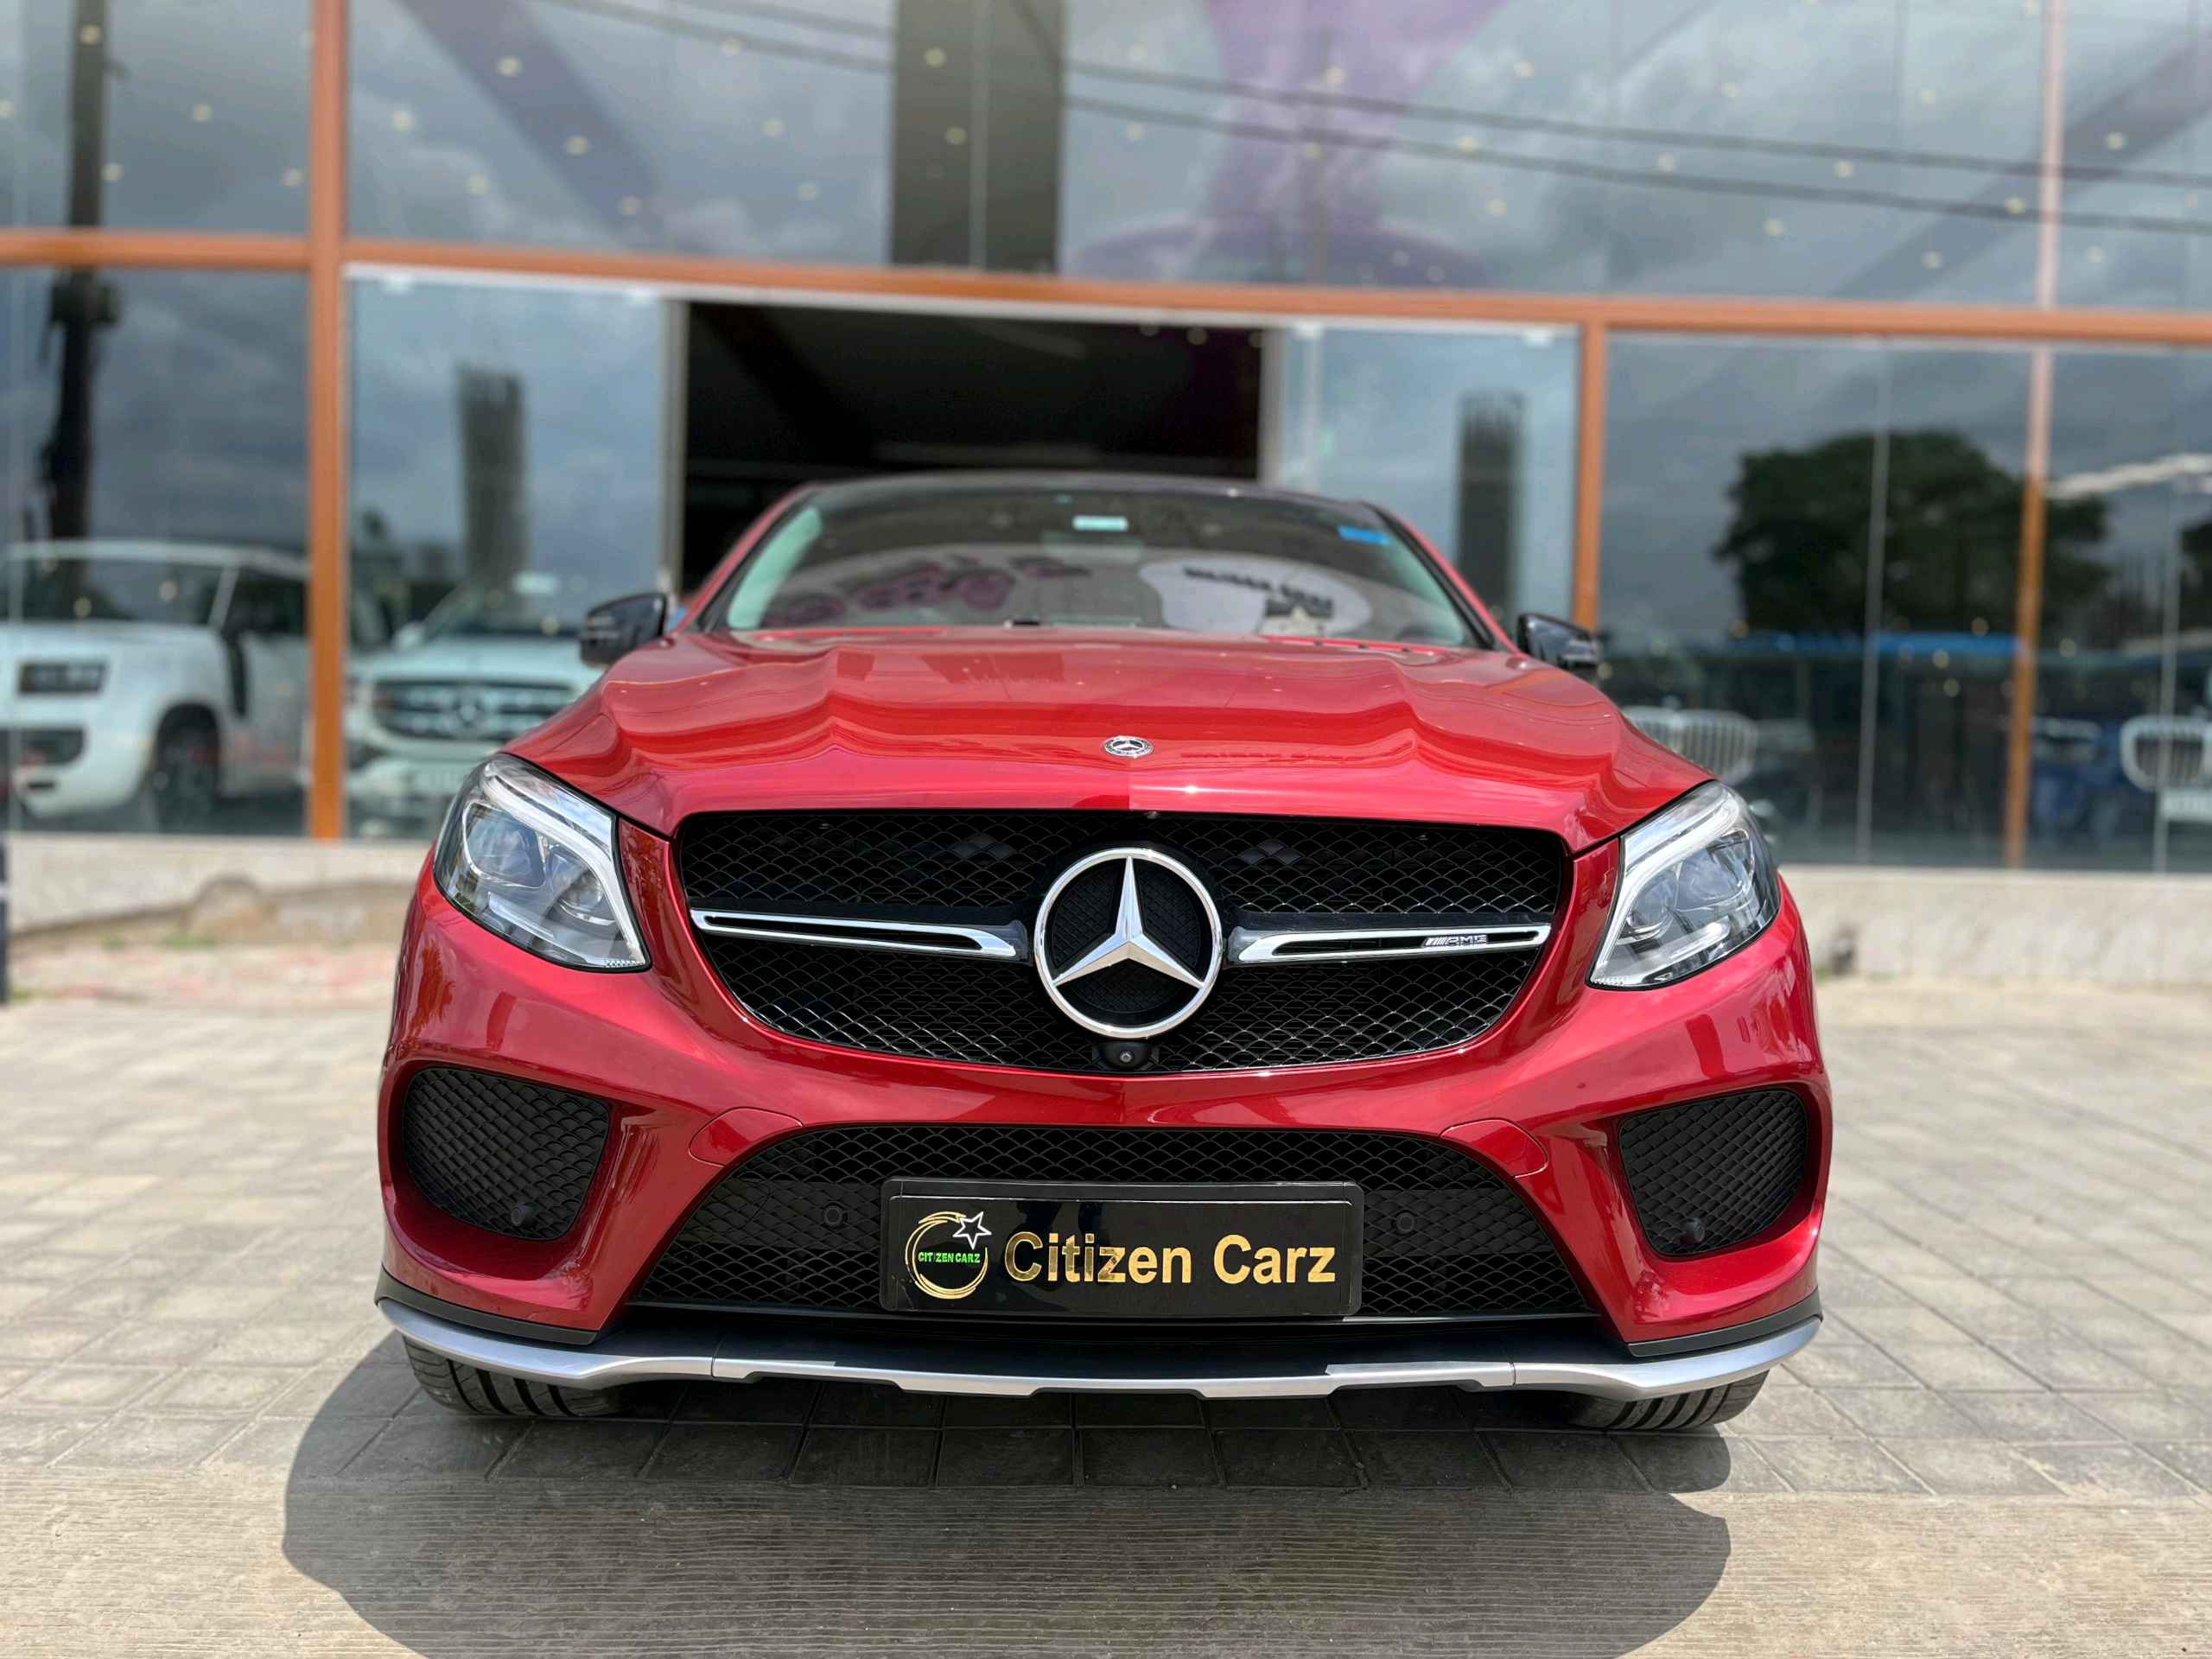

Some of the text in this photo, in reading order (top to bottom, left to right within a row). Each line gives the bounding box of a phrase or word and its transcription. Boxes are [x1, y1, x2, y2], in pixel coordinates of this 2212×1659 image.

[955, 1252, 981, 1263] CARZ
[1004, 1230, 1336, 1285] Citizen Carz
